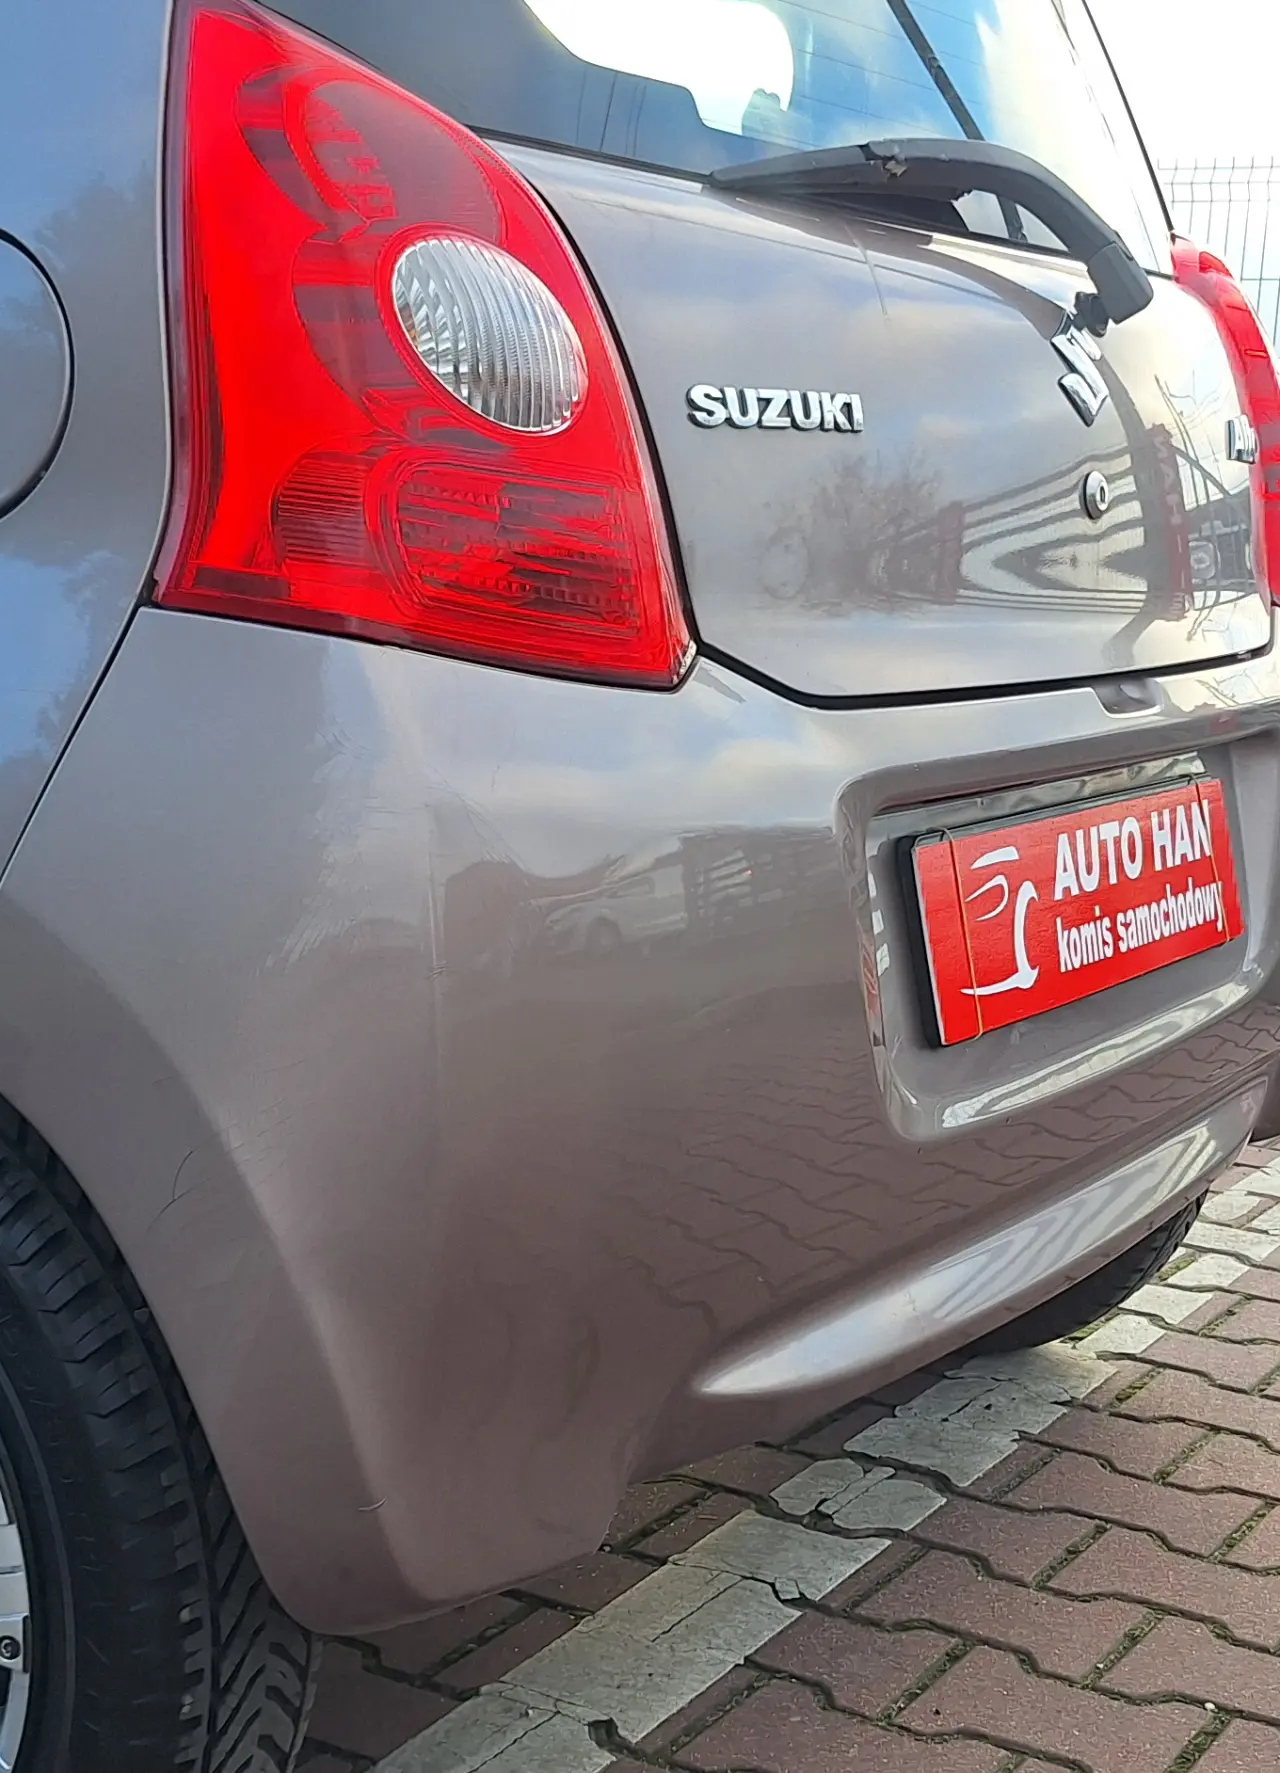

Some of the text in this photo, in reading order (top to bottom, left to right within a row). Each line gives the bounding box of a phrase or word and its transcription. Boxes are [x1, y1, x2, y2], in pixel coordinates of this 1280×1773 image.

[686, 383, 865, 433] SUZUKI
[1053, 799, 1212, 900] AUTO HAN
[1056, 877, 1223, 973] komis samochodowy
